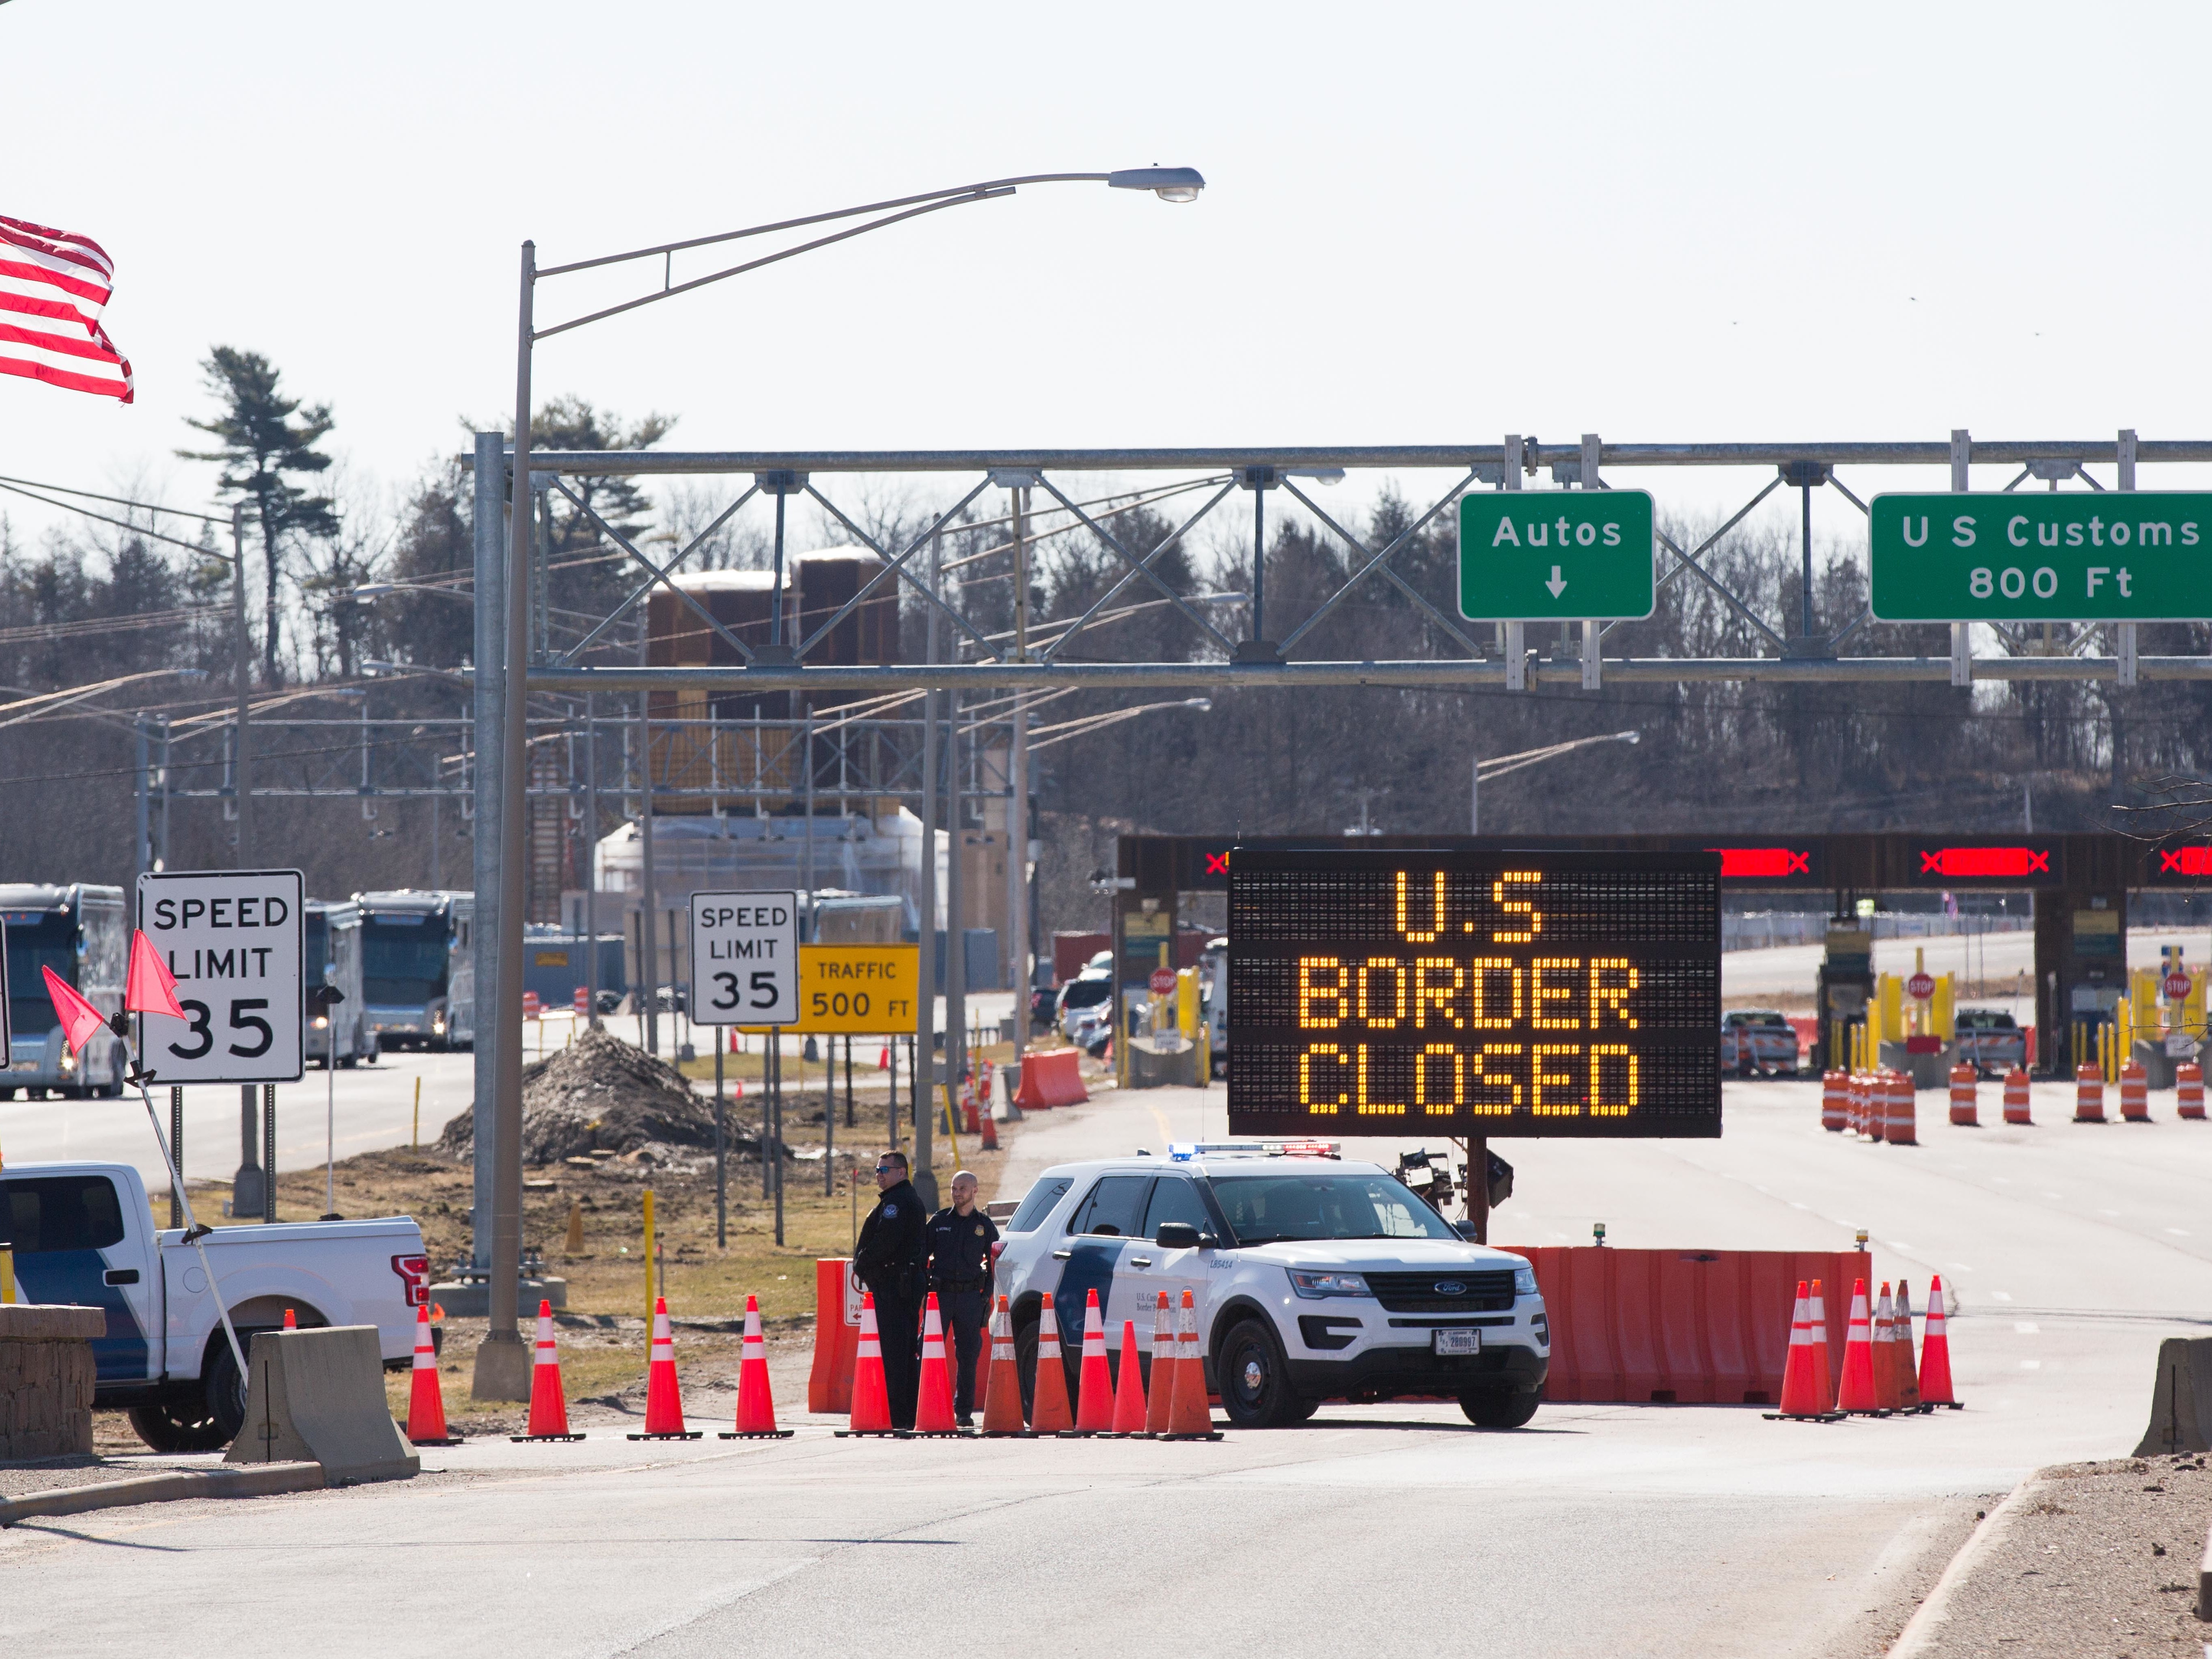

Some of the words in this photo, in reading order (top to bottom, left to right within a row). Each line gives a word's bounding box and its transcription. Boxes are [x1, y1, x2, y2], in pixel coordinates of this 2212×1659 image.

[1493, 517, 1620, 546] Autos
[1904, 516, 1928, 546] U
[1952, 516, 1976, 546] S
[2007, 515, 2199, 546] Customs
[1971, 568, 2057, 597] 800
[2088, 568, 2131, 597] Ft
[153, 897, 288, 930] SPEED
[701, 907, 787, 928] SPEED
[1396, 871, 1541, 943] U.S
[169, 947, 273, 979] LIMIT
[710, 939, 778, 959] LIMIT
[818, 962, 896, 979] TRAFFIC
[711, 971, 779, 1010] 35
[1299, 957, 1638, 1029] BORDER
[1910, 980, 1934, 993] STOP
[2166, 980, 2190, 993] STOP
[812, 991, 871, 1017] 500
[888, 1000, 909, 1017] FT
[168, 999, 273, 1059] 35
[1300, 1043, 1638, 1116] CLOSED
[1443, 1283, 1460, 1291] Ford
